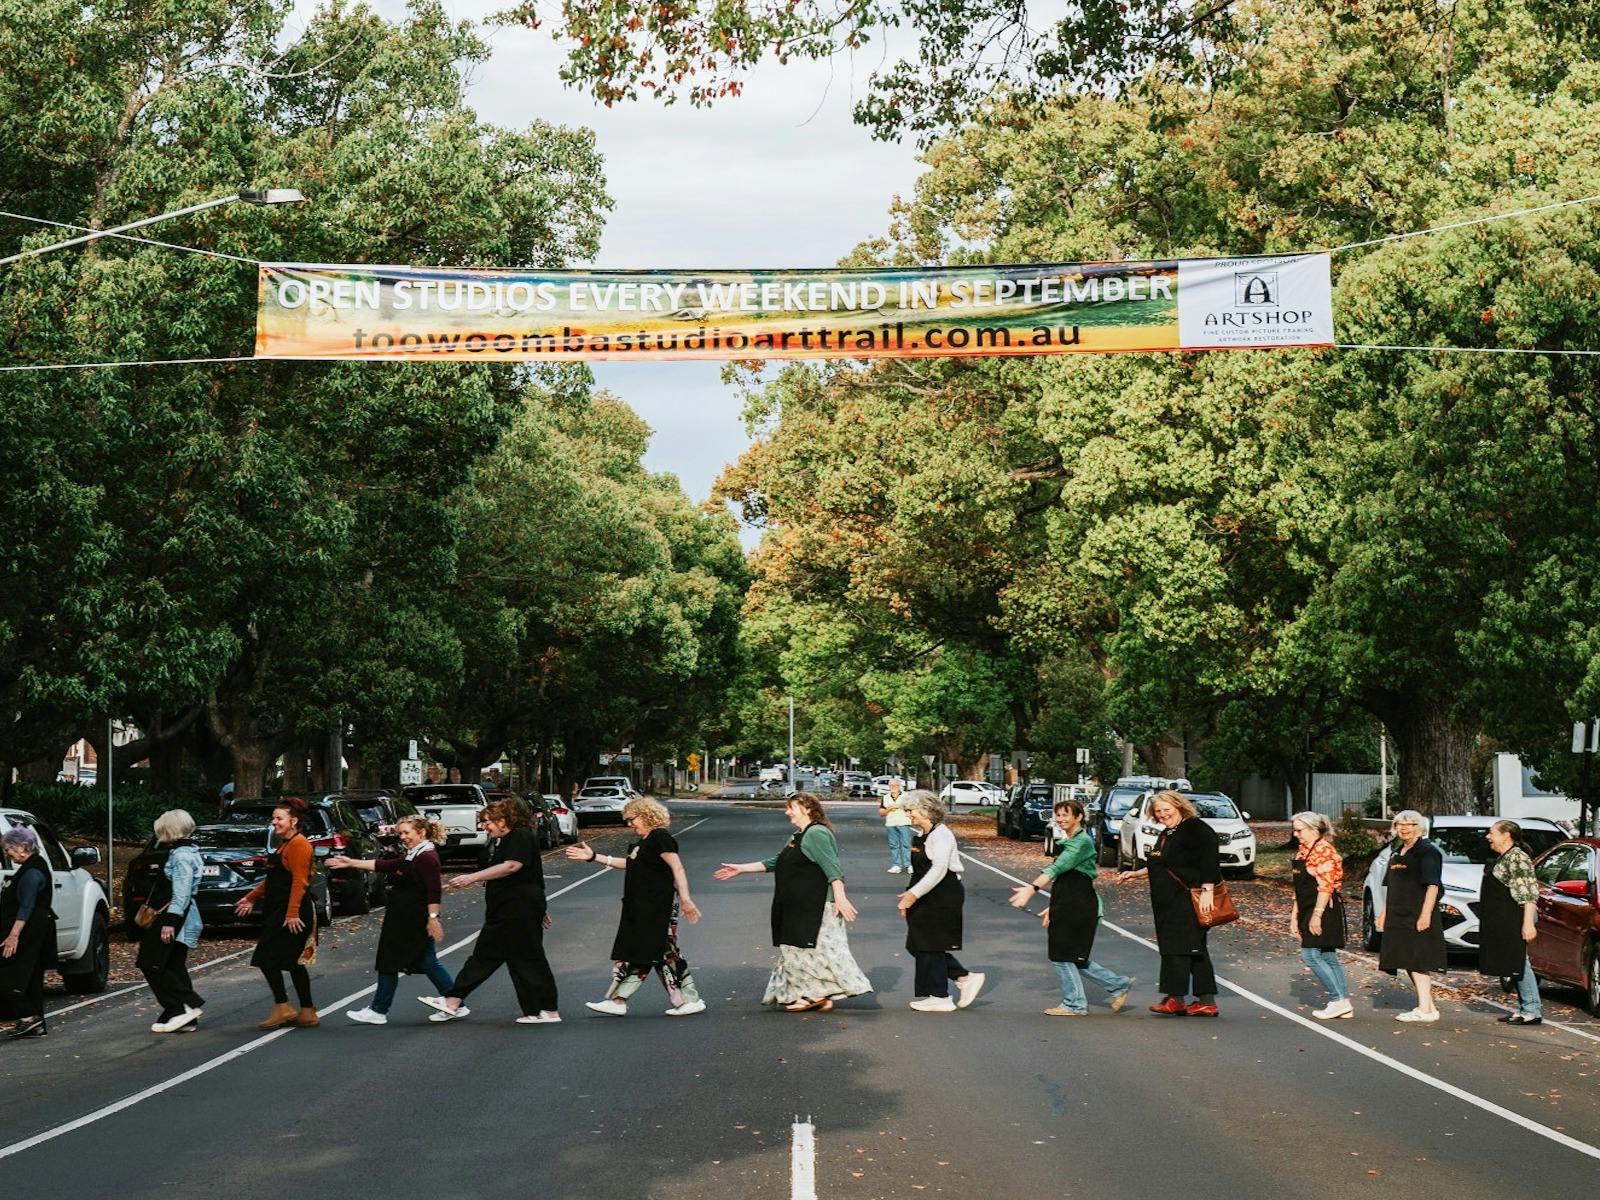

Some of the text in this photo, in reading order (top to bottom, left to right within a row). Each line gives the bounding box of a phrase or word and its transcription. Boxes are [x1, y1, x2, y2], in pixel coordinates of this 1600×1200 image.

[278, 275, 1173, 312] OPEN STUDIOS EVERY WEEKEND IN SEPTEMBER
[1205, 310, 1312, 328] ARTSHOP
[352, 322, 1081, 353] toowoombastudioarttrail.com.au
